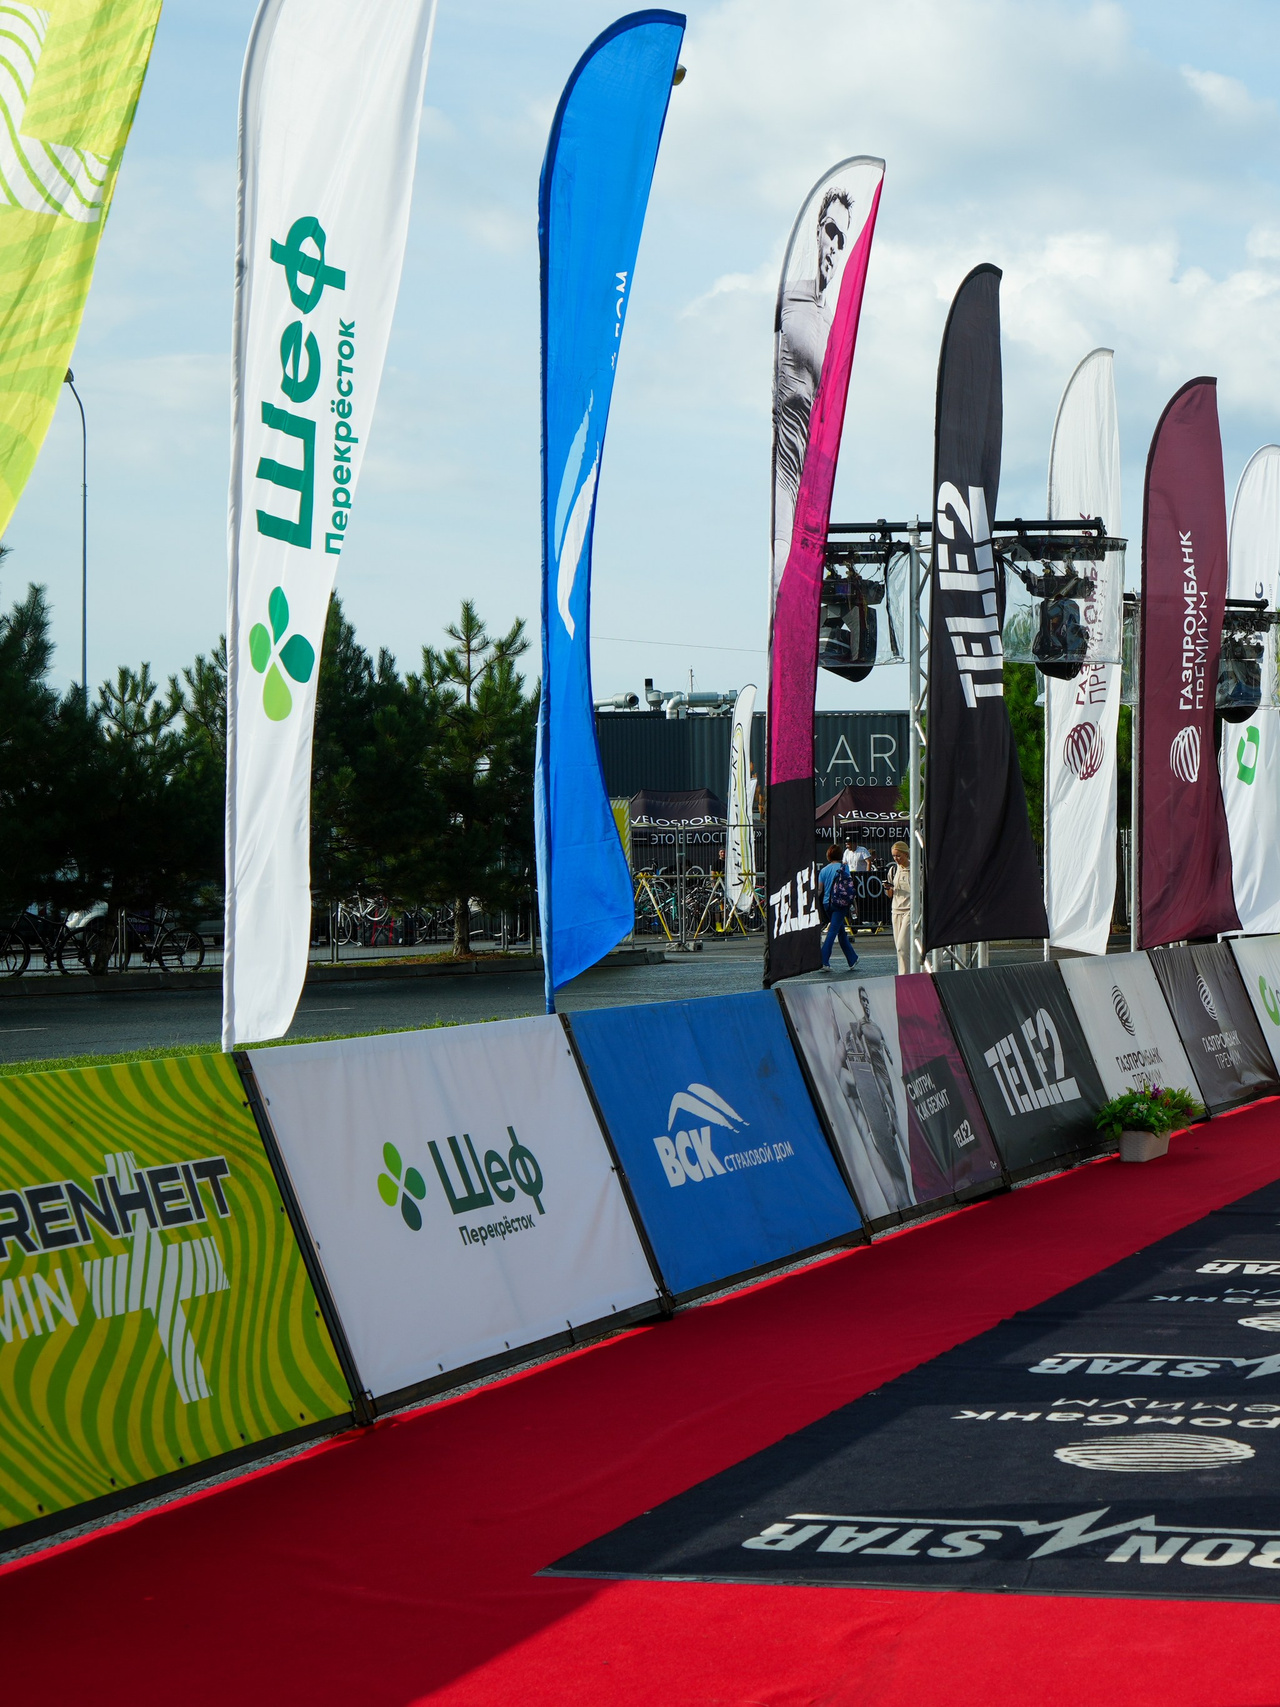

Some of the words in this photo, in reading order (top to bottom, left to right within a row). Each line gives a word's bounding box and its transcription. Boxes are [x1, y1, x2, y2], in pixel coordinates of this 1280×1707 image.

[256, 216, 346, 549] Шеф
[325, 318, 359, 555] Перекрёсток
[937, 481, 1004, 708] TELE2
[1178, 530, 1198, 710] ГАЗПРОМБАНК
[815, 734, 896, 773] AR
[835, 777, 878, 787] FOOD
[984, 1008, 1082, 1116] TELE2
[953, 1119, 975, 1149] TELE2
[427, 1125, 546, 1215] Шеф
[724, 1142, 773, 1172] СТРАХОВОЙ
[773, 1140, 795, 1163] ДОМ
[458, 1213, 536, 1246] Перекрёсток
[1027, 1357, 1222, 1379] STAR
[741, 1522, 1003, 1558] STAR
